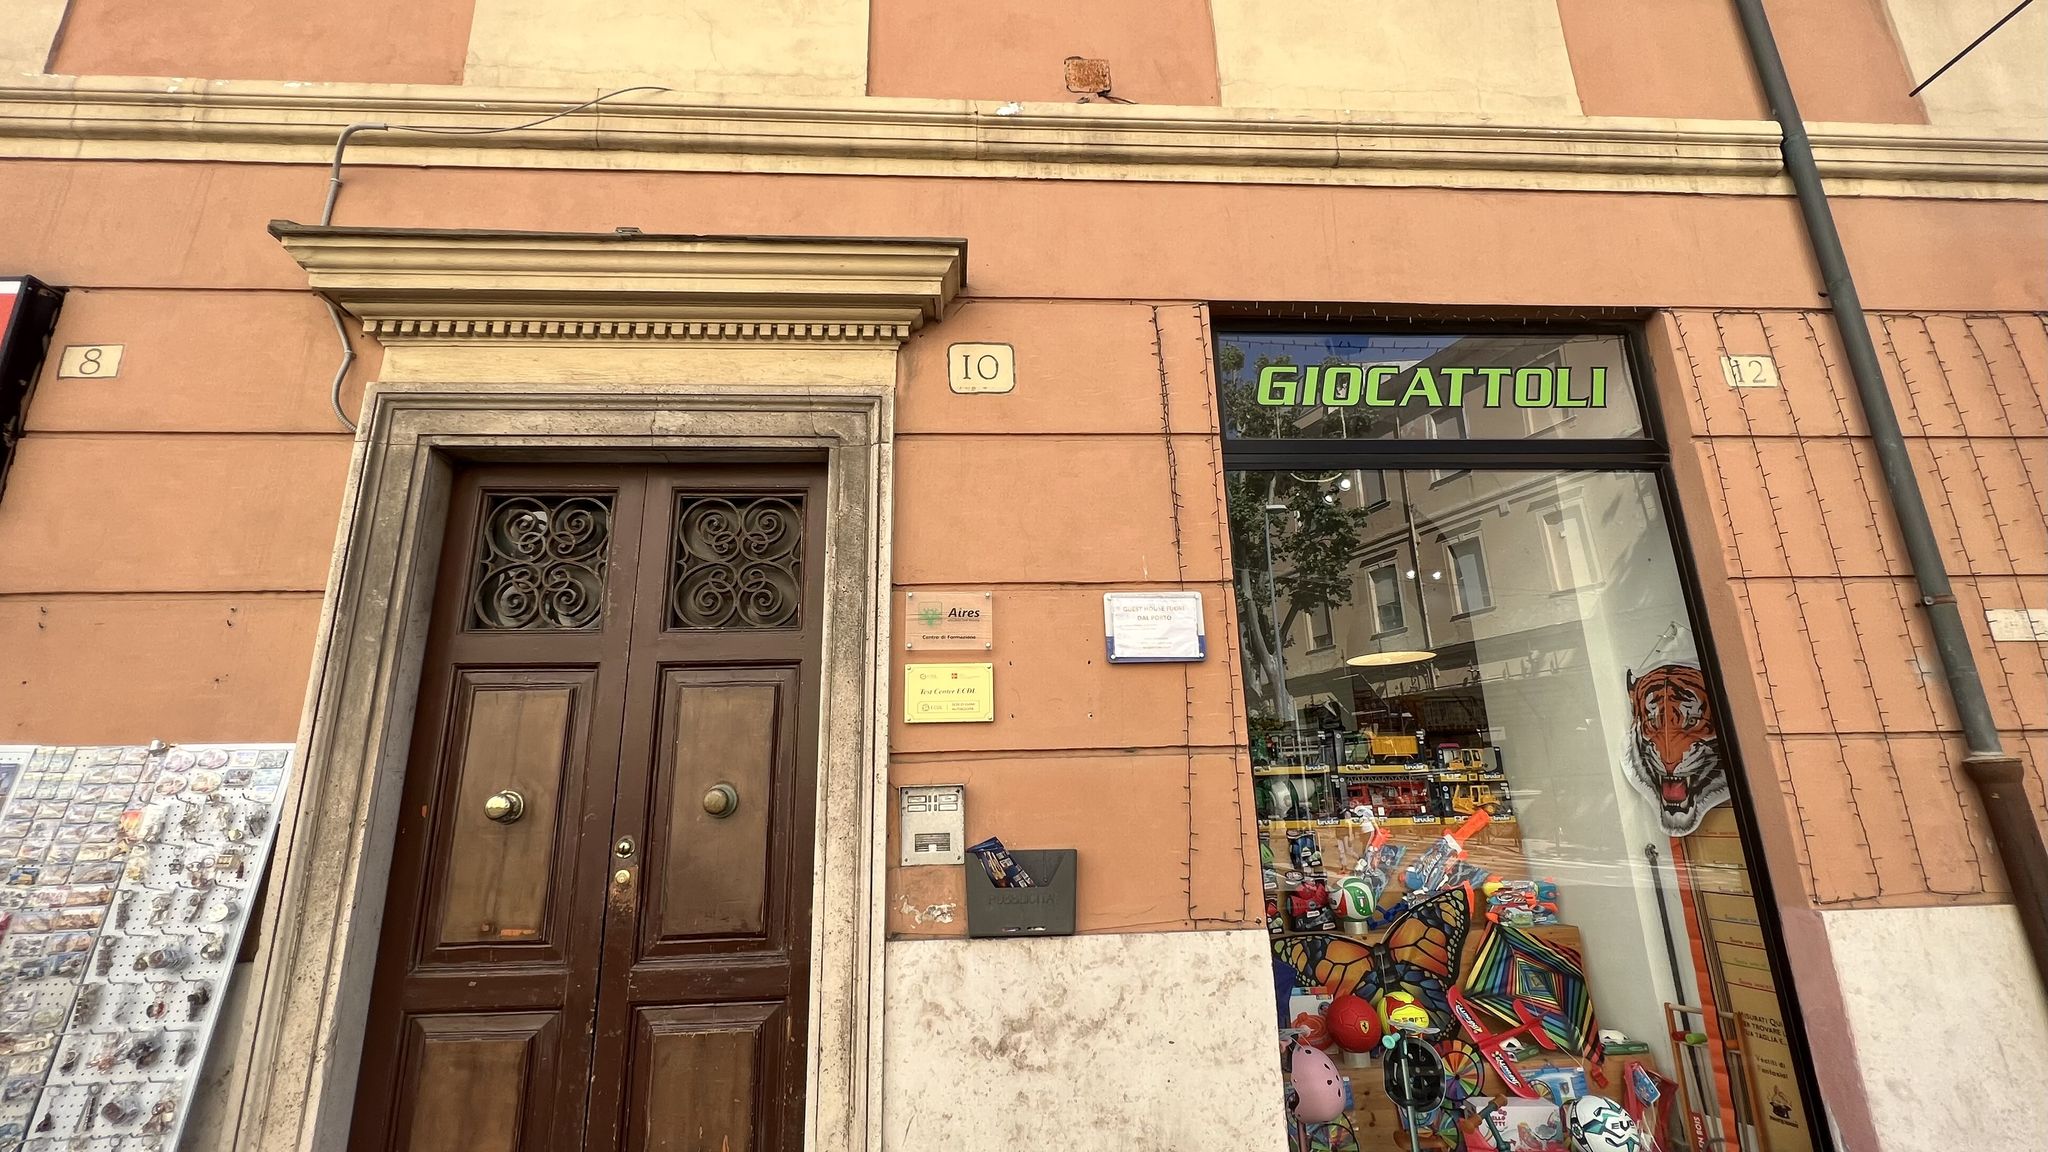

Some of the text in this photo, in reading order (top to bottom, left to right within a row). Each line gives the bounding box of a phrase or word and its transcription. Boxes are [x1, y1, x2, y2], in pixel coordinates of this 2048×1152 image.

[79, 348, 102, 375] 8
[1733, 359, 1767, 383] 12
[1256, 365, 1608, 409] GIOCATTOLI
[947, 607, 980, 618] Aires
[1413, 815, 1436, 823] bruder
